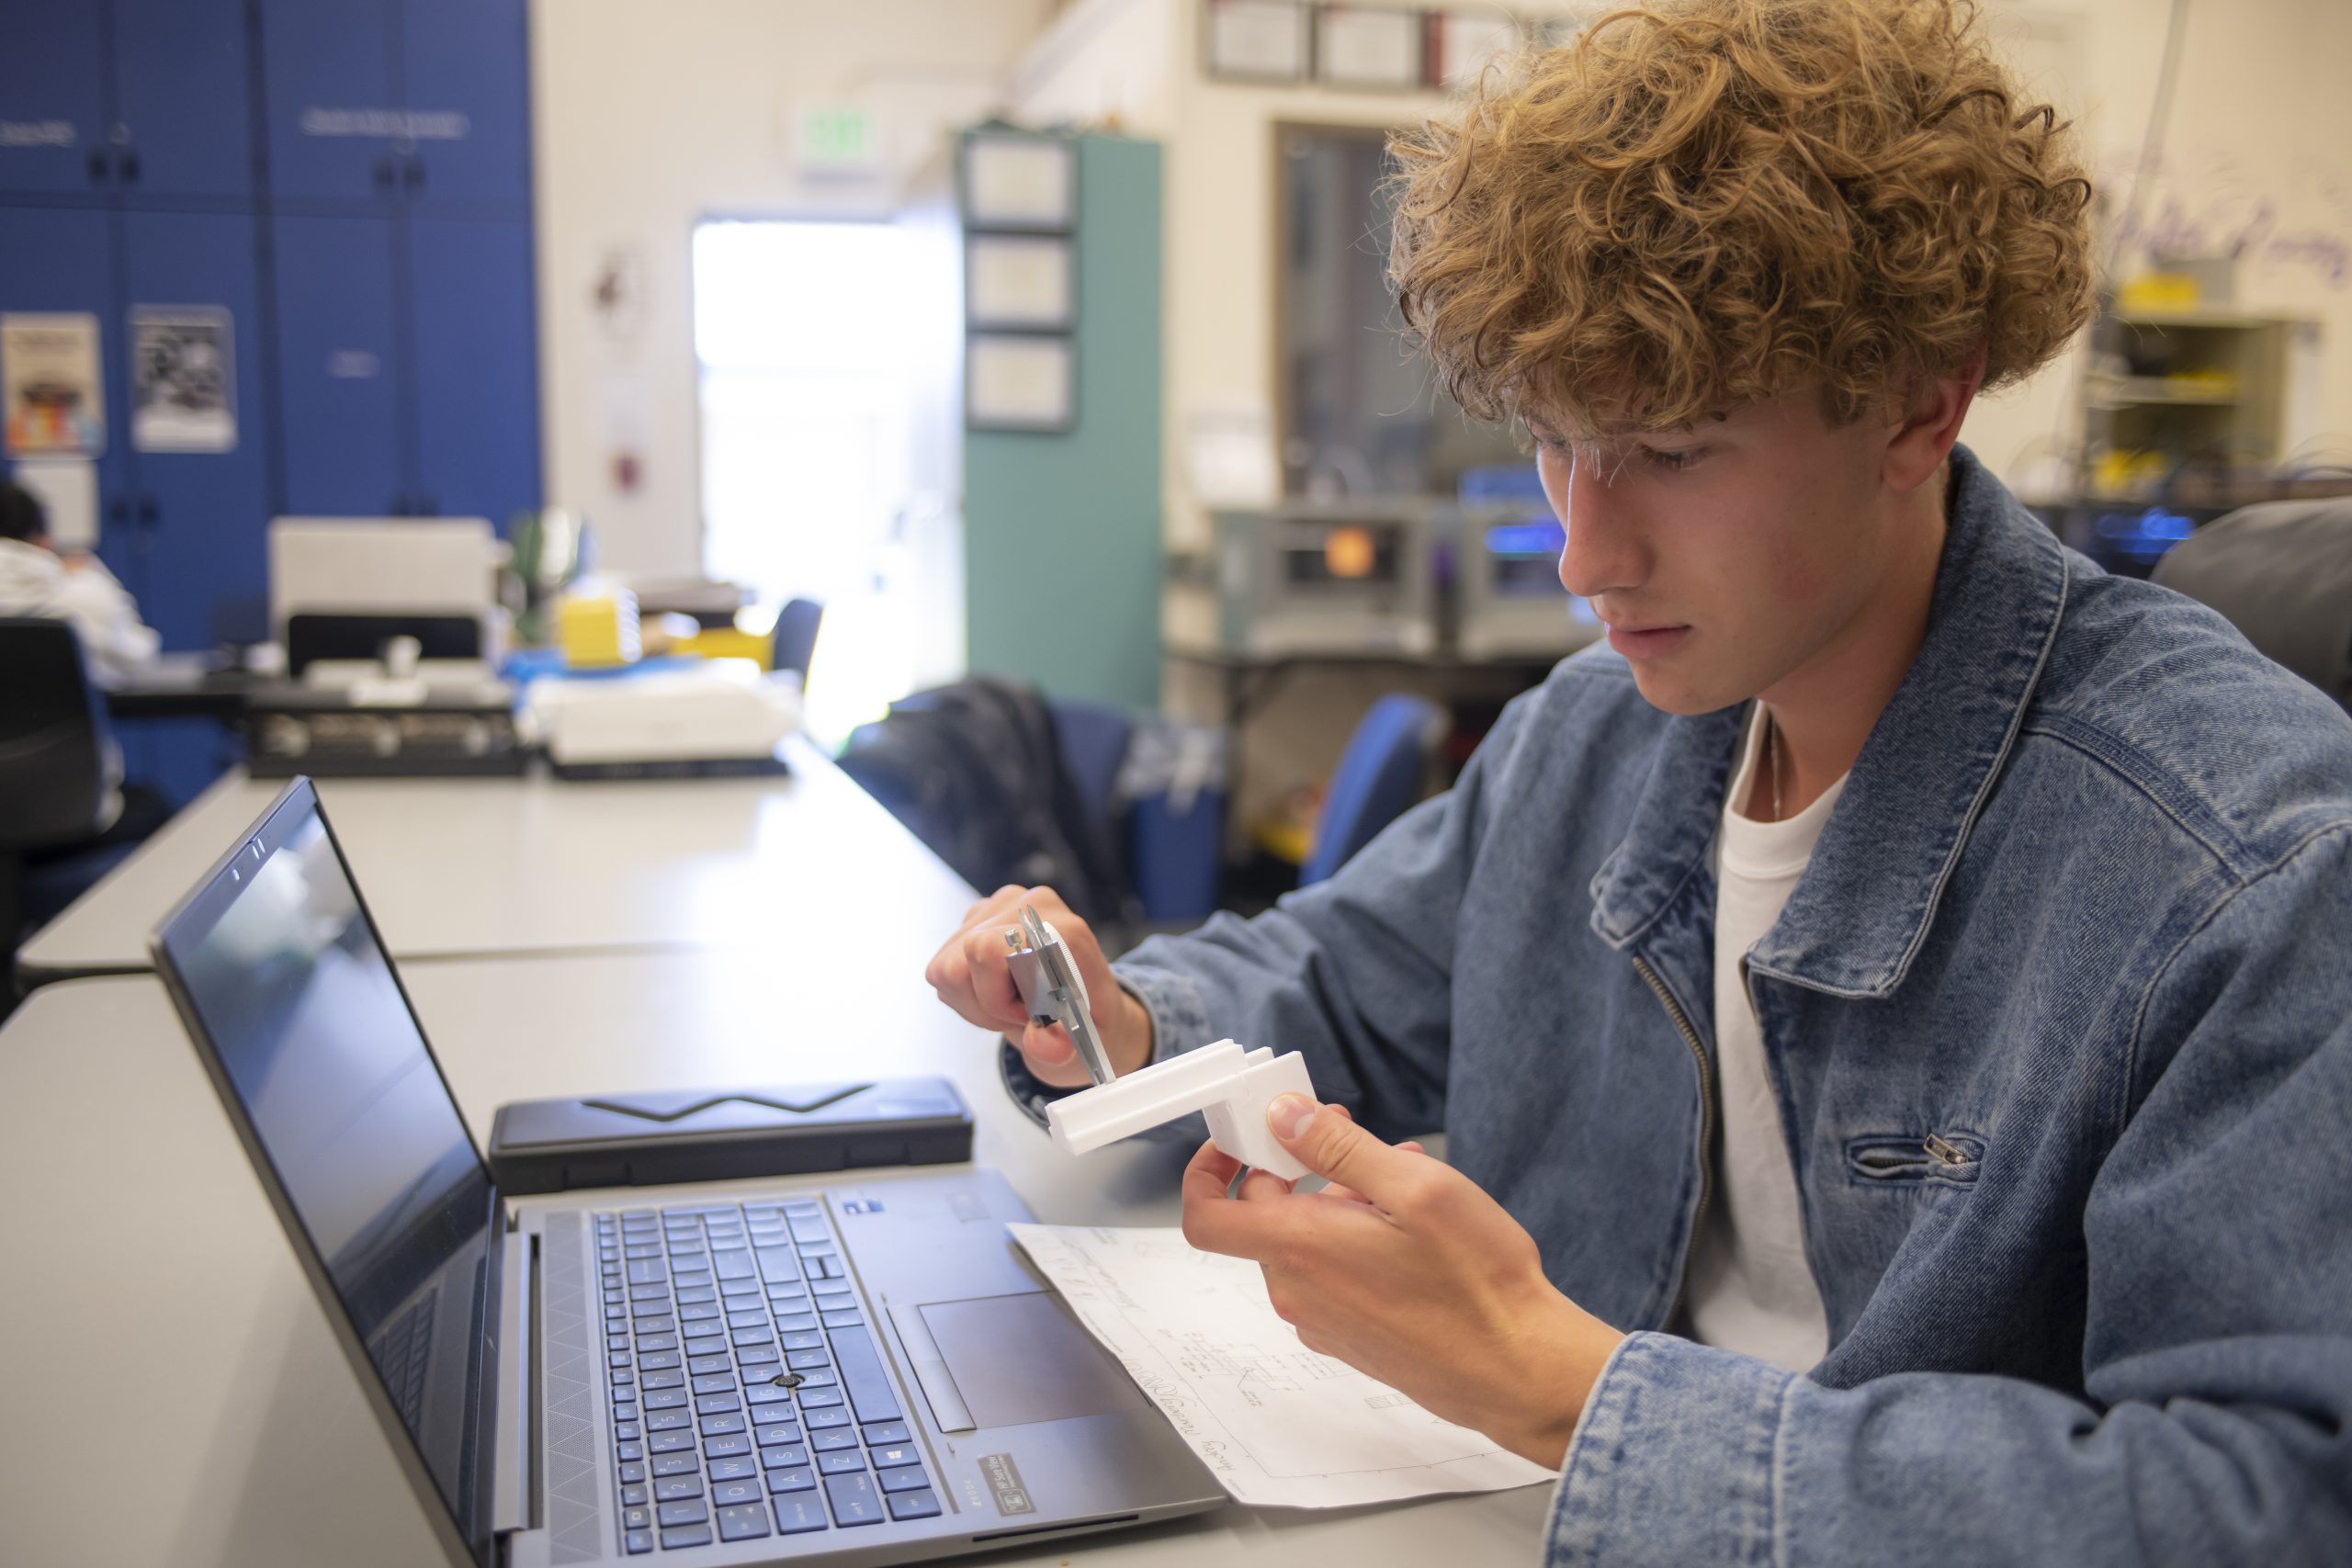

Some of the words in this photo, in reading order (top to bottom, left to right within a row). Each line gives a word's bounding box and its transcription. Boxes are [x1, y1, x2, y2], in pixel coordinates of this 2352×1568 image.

[826, 1434, 842, 1442] X
[832, 1457, 850, 1465] Z
[989, 1456, 1000, 1470] View
[723, 1463, 739, 1473] W
[993, 1468, 1006, 1482] Sure
[996, 1481, 1009, 1489] HP
[728, 1487, 745, 1496] Q
